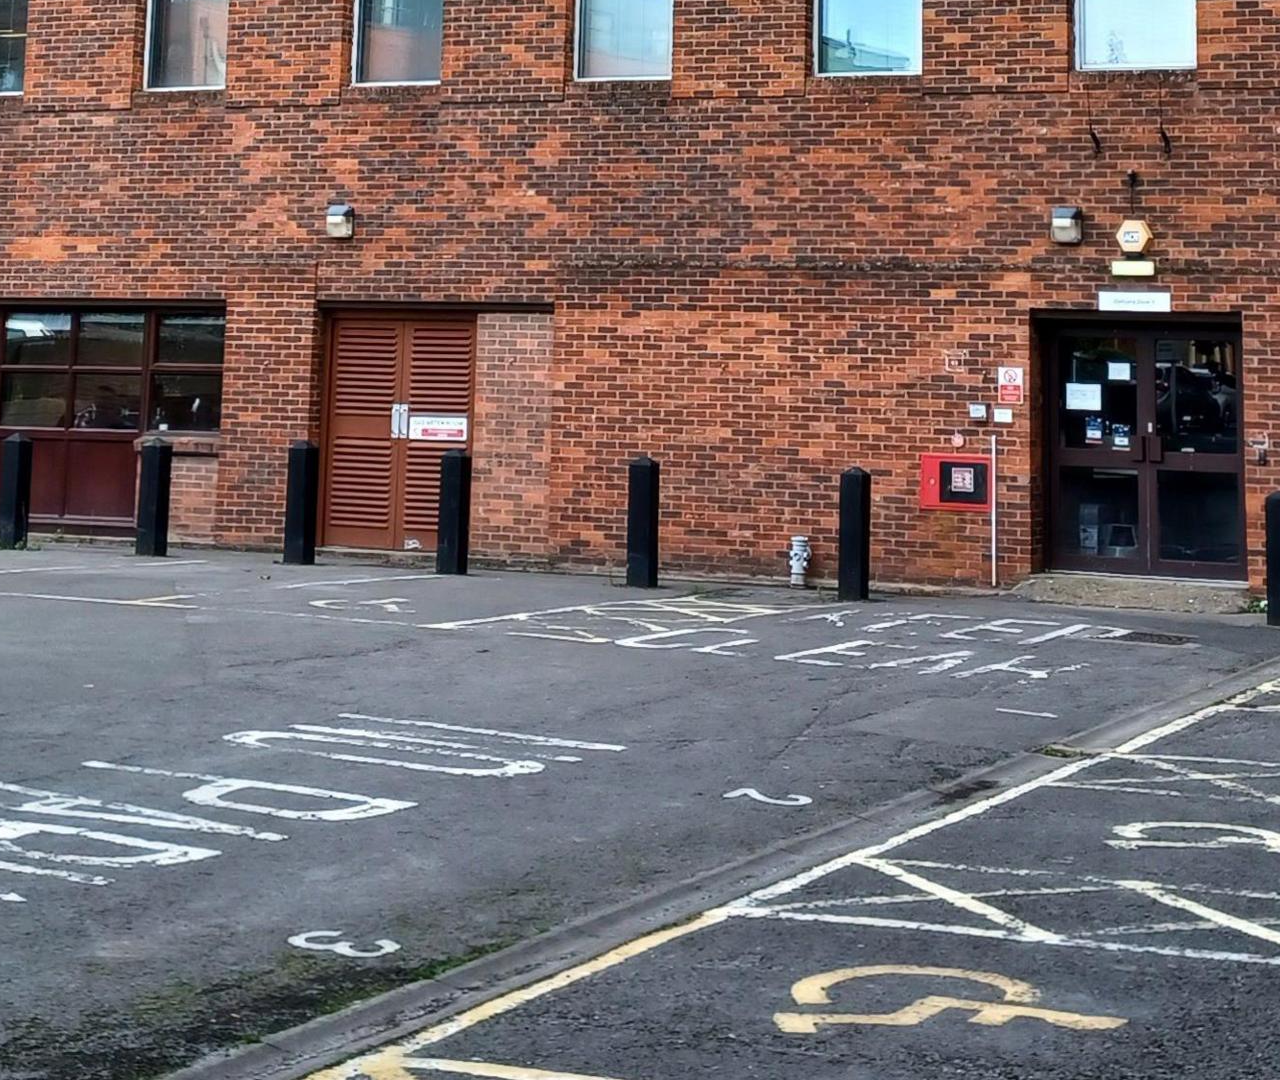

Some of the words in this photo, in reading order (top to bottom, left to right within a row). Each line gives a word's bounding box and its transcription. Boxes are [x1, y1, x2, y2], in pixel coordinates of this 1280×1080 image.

[222, 713, 628, 777] NO
[722, 788, 813, 806] 2
[287, 930, 402, 957] 3
